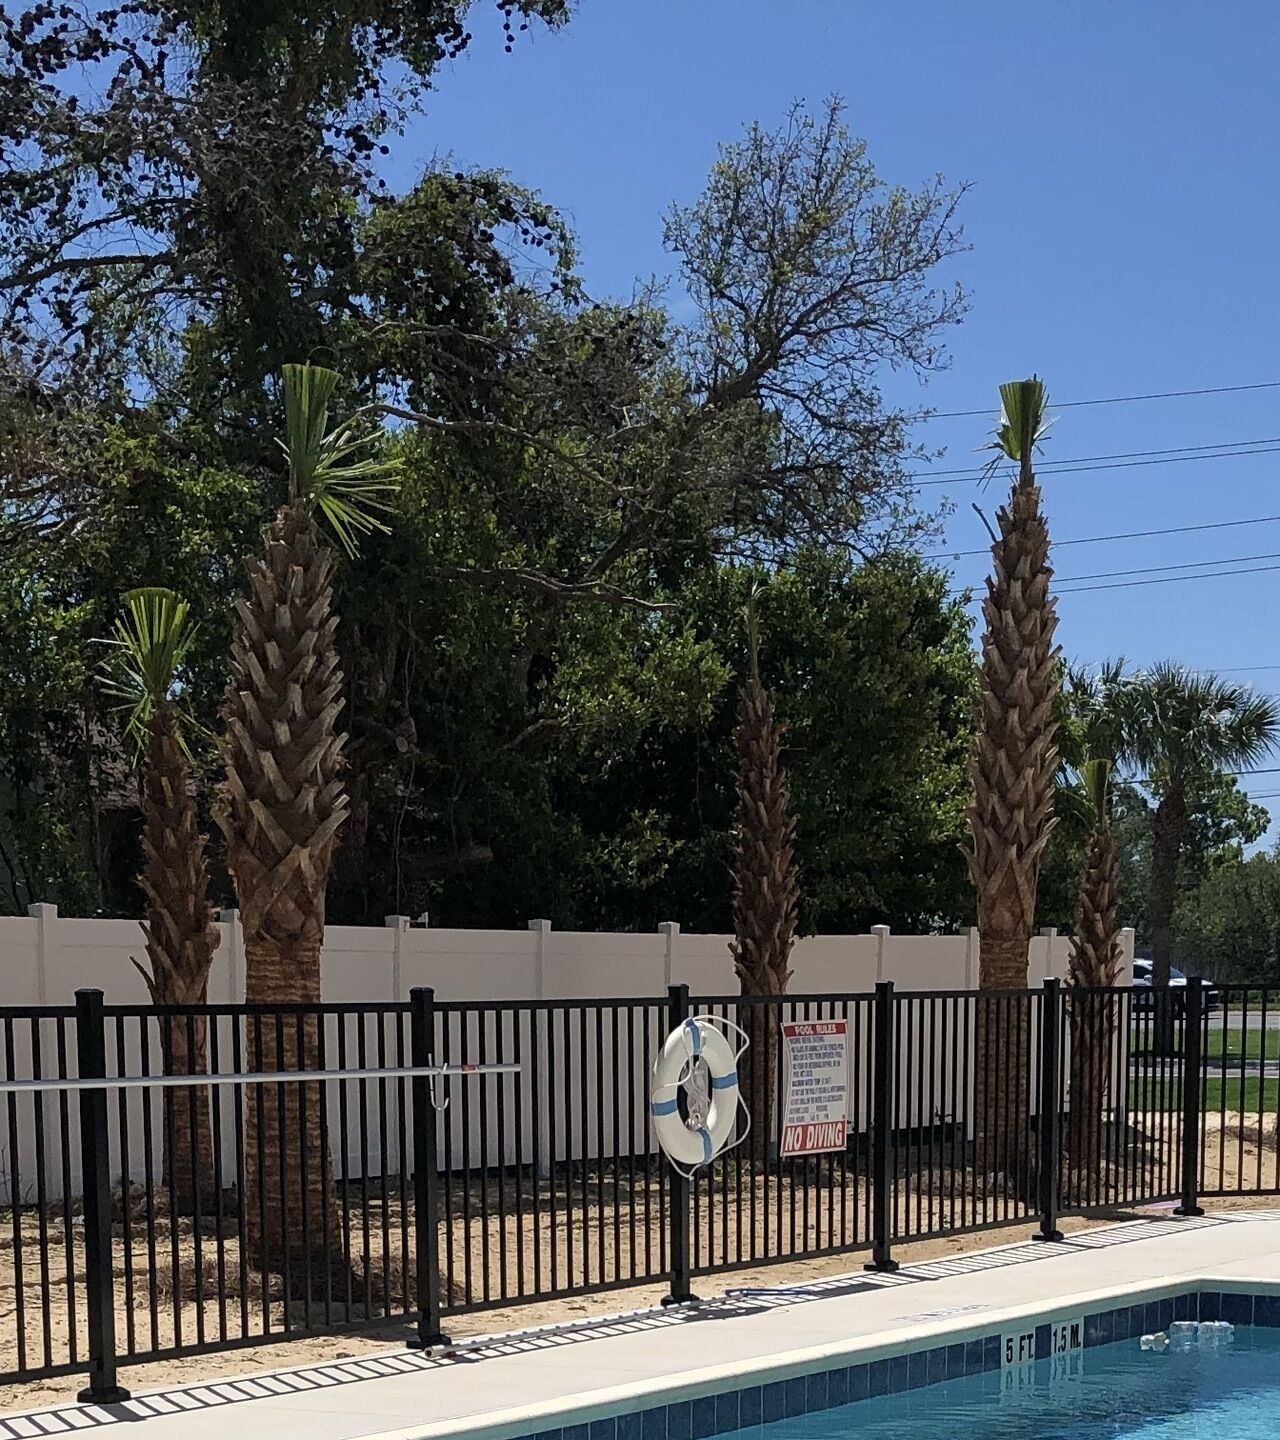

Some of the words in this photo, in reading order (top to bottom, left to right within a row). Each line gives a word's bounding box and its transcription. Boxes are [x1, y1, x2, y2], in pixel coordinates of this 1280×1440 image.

[794, 1025, 814, 1036] POOL
[815, 1023, 837, 1034] RULES
[785, 1126, 803, 1151] NO
[806, 1122, 843, 1149] DIVING
[1006, 1337, 1014, 1364] 5
[1019, 1332, 1034, 1362] FT.
[1053, 1326, 1067, 1354] 1.5
